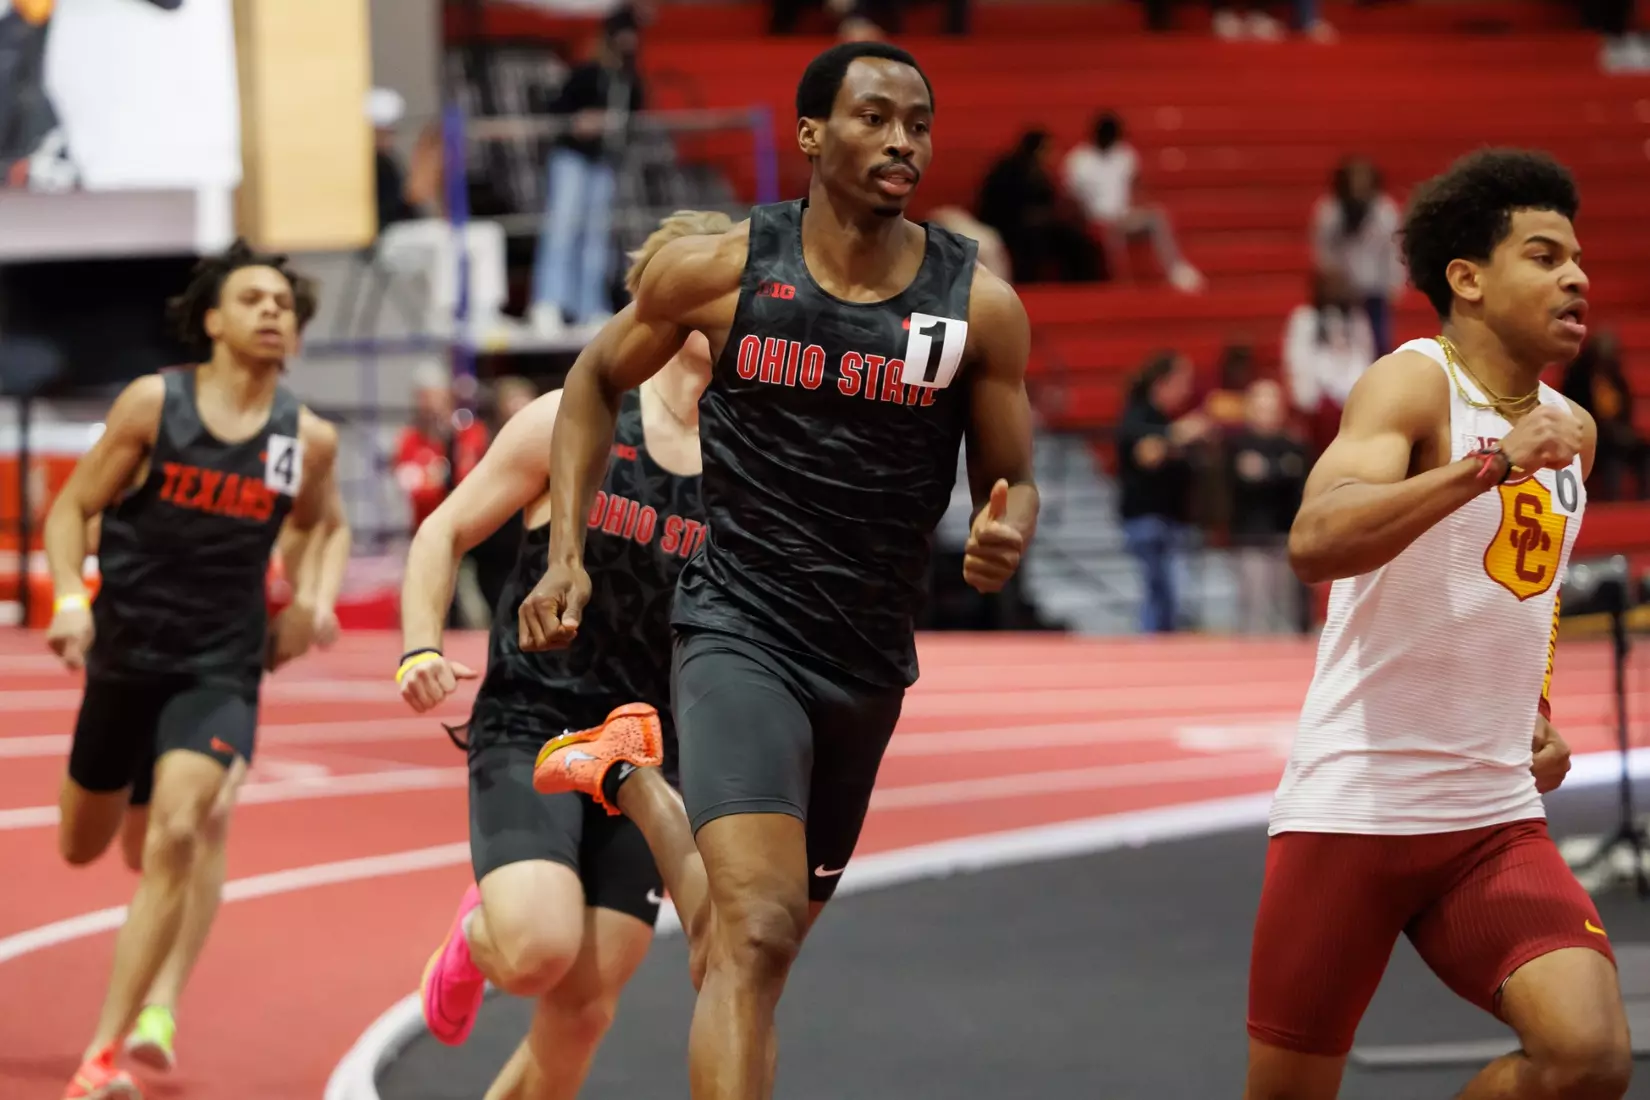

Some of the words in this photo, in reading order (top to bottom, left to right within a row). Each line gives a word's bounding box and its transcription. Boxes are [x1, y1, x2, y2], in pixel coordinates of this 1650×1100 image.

[736, 334, 826, 390] OHIO
[919, 320, 947, 383] 1
[160, 460, 279, 522] TEXANS
[275, 446, 294, 485] 4
[1509, 492, 1551, 584] SC
